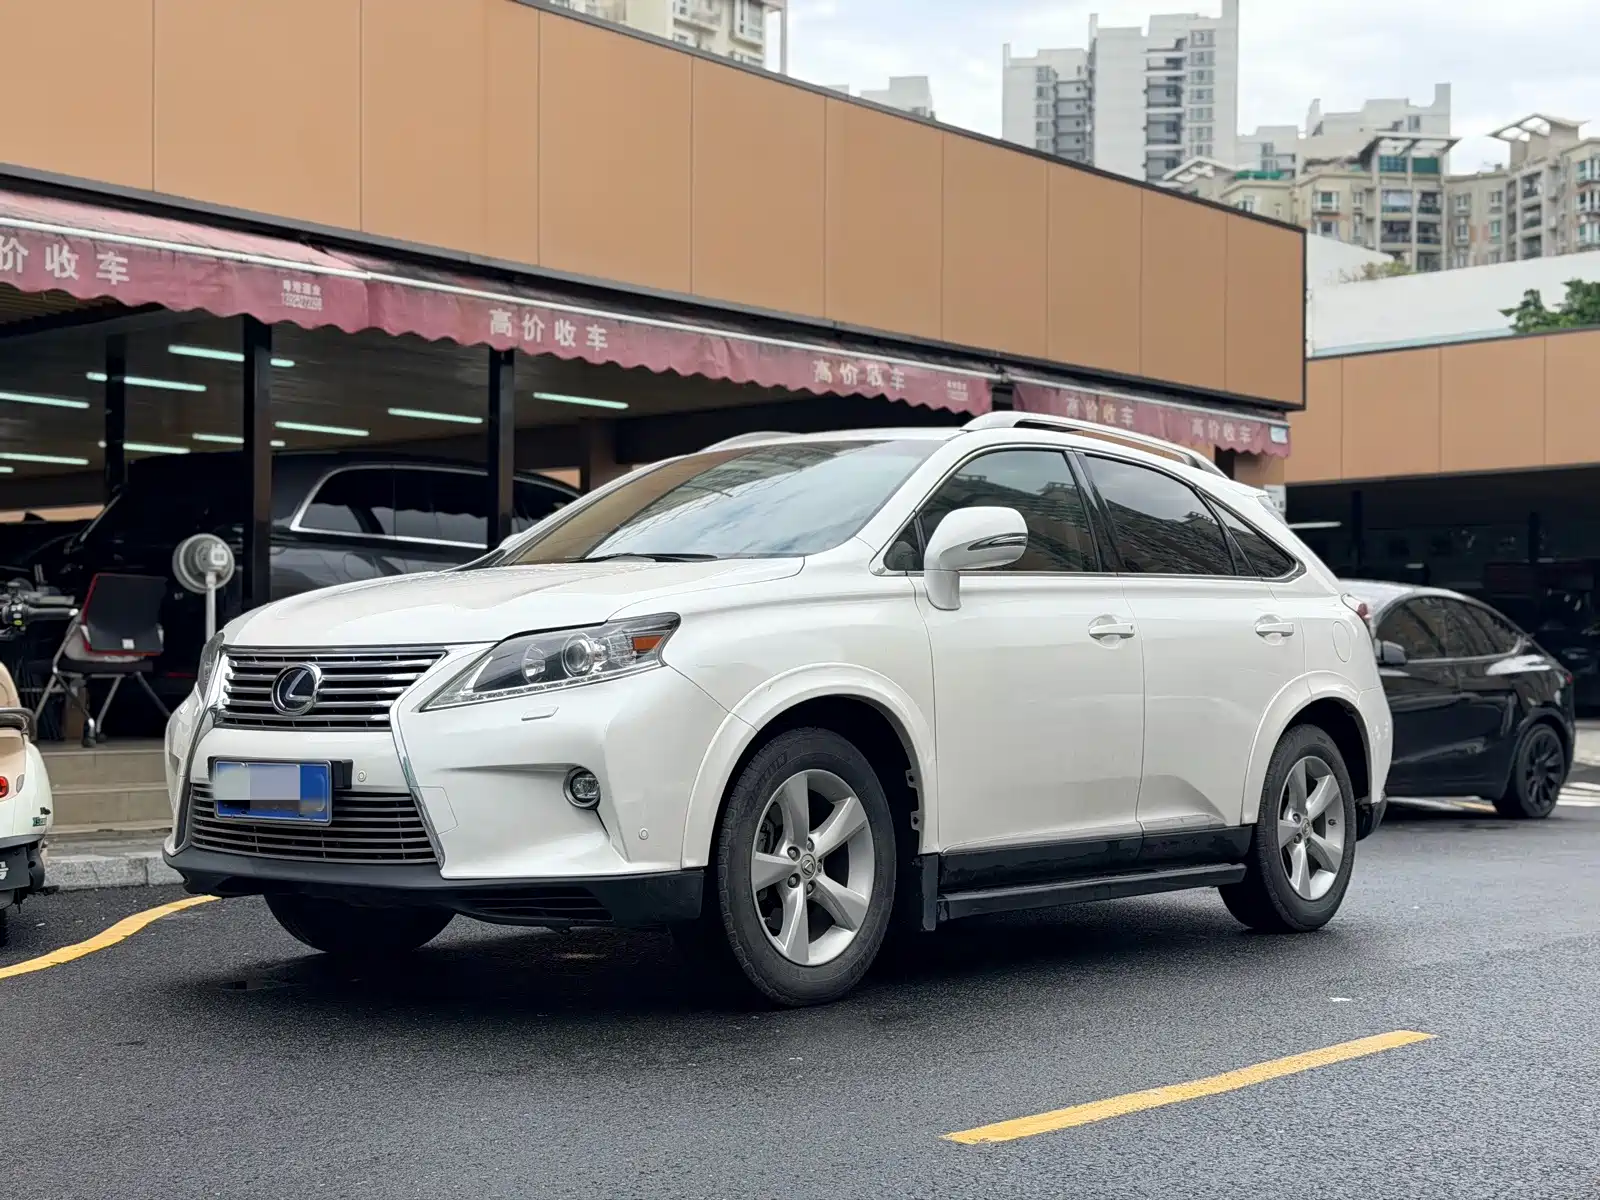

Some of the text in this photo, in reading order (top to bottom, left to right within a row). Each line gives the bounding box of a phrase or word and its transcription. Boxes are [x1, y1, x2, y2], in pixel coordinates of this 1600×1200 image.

[0, 236, 130, 285] 价收车
[490, 308, 608, 351] 高价收车
[813, 359, 905, 391] 高价收车
